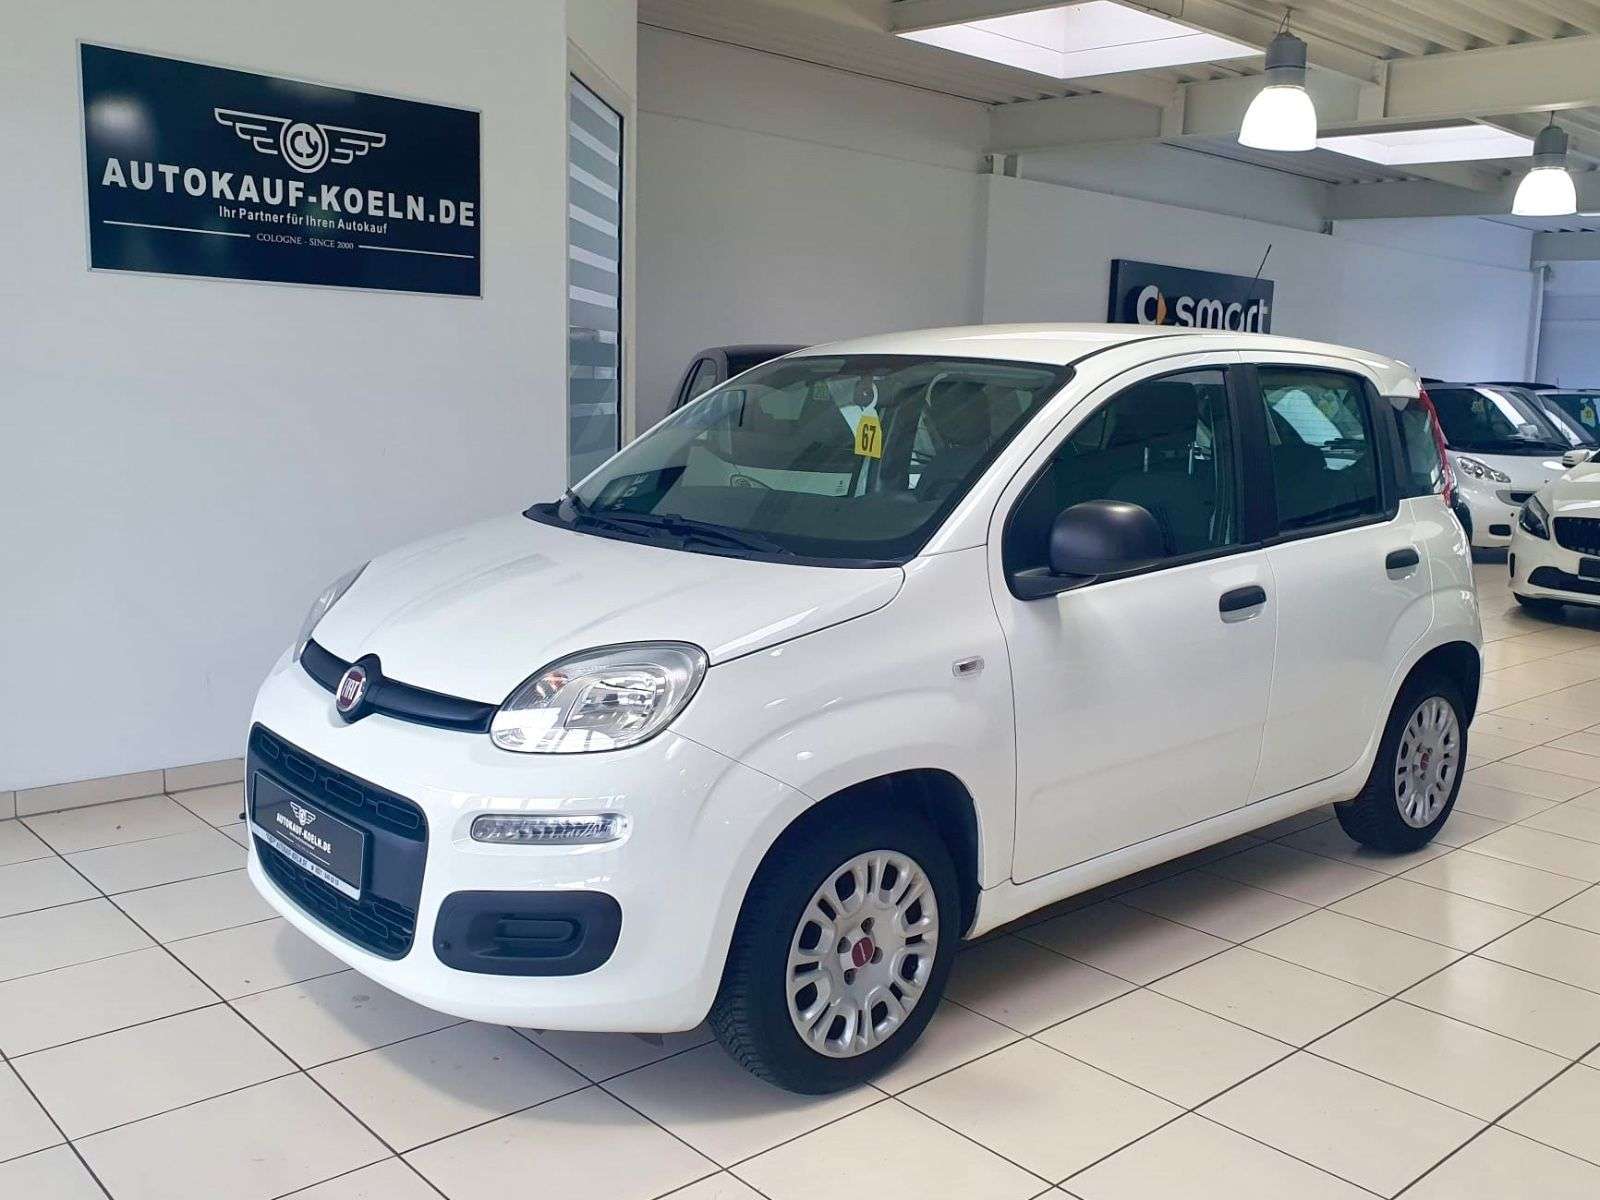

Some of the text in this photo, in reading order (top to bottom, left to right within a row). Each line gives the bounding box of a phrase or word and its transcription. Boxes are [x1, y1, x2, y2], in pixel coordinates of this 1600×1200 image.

[102, 157, 475, 227] AUTOKAUF-KOELN.DE
[219, 205, 388, 235] Ihr Partner für Ihren Autokauf
[256, 232, 302, 245] COLOGNE
[309, 238, 335, 249] SINCE
[1175, 296, 1269, 334] smart
[861, 423, 877, 453] 67
